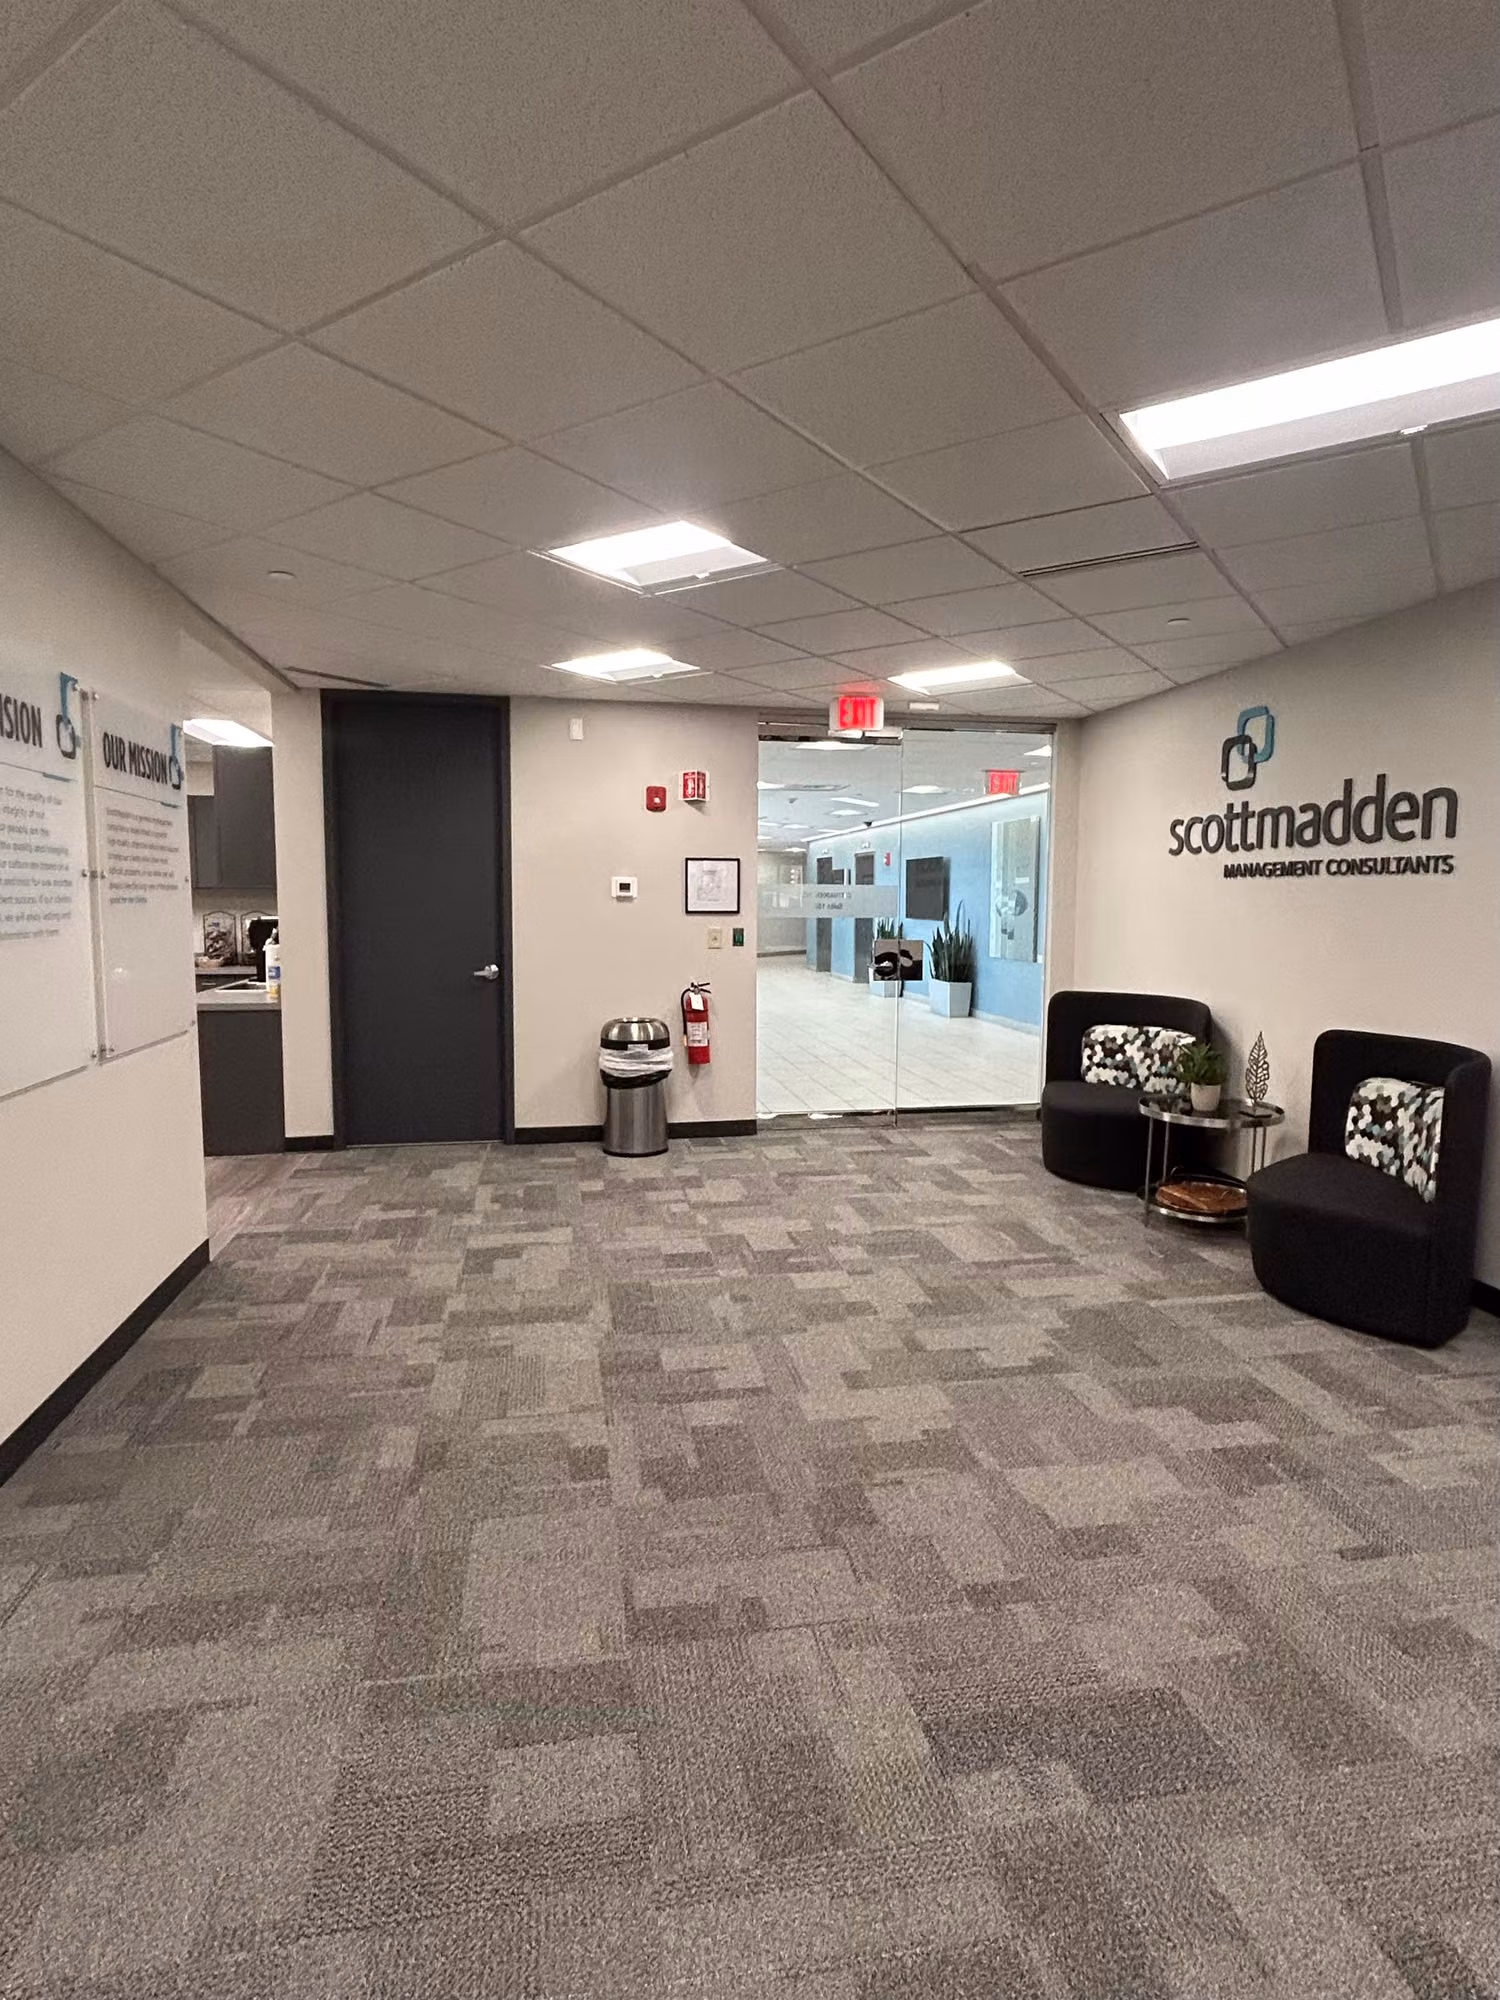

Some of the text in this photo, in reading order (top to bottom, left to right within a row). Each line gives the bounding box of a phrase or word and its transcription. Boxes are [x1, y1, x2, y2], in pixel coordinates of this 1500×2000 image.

[840, 698, 876, 729] EXIT
[103, 732, 168, 785] OUR MISSION
[1168, 773, 1458, 856] scottmadden
[1223, 854, 1455, 879] MANAGEMENT CONSULTANTS
